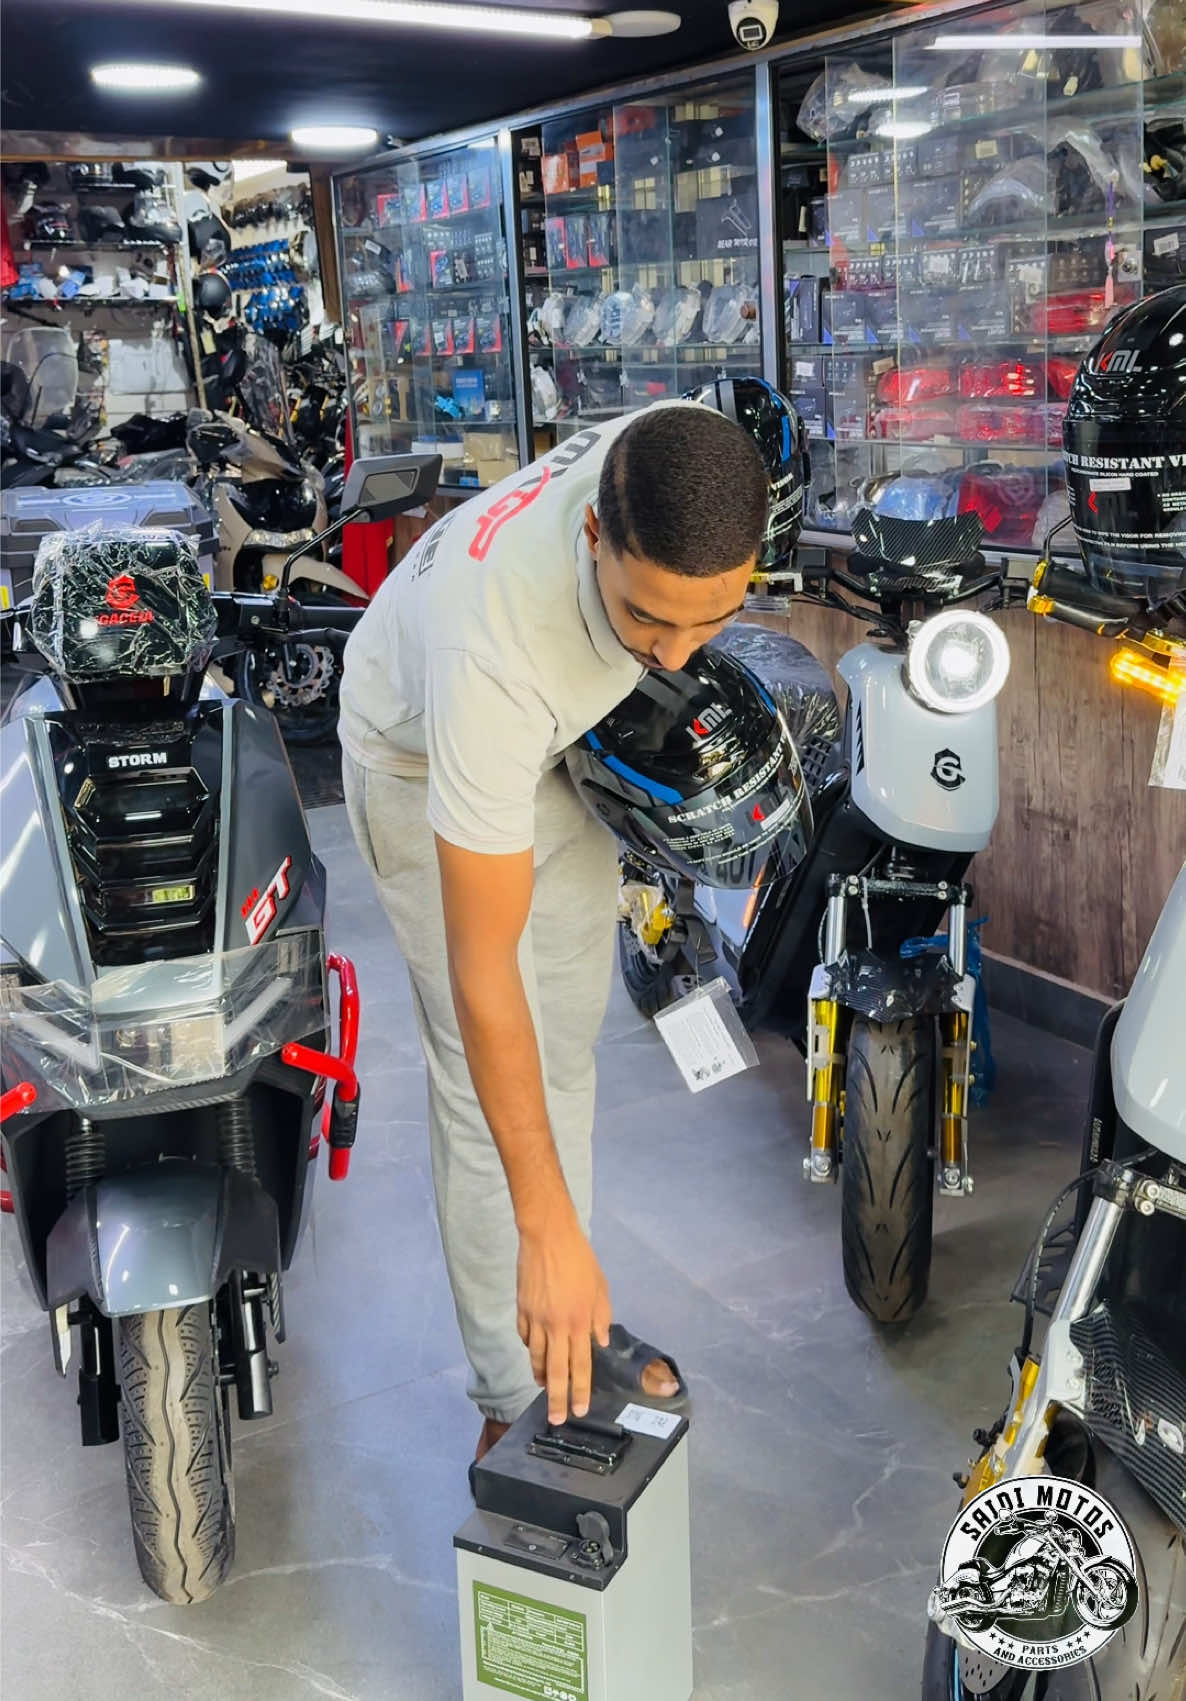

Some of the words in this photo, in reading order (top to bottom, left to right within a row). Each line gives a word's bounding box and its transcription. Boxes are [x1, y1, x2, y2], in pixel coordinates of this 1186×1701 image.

[1080, 456, 1165, 470] RESISTANT
[108, 752, 168, 769] STORM
[667, 795, 732, 824] SCRATCH
[733, 742, 783, 800] RESISTANT
[245, 855, 293, 946] GT
